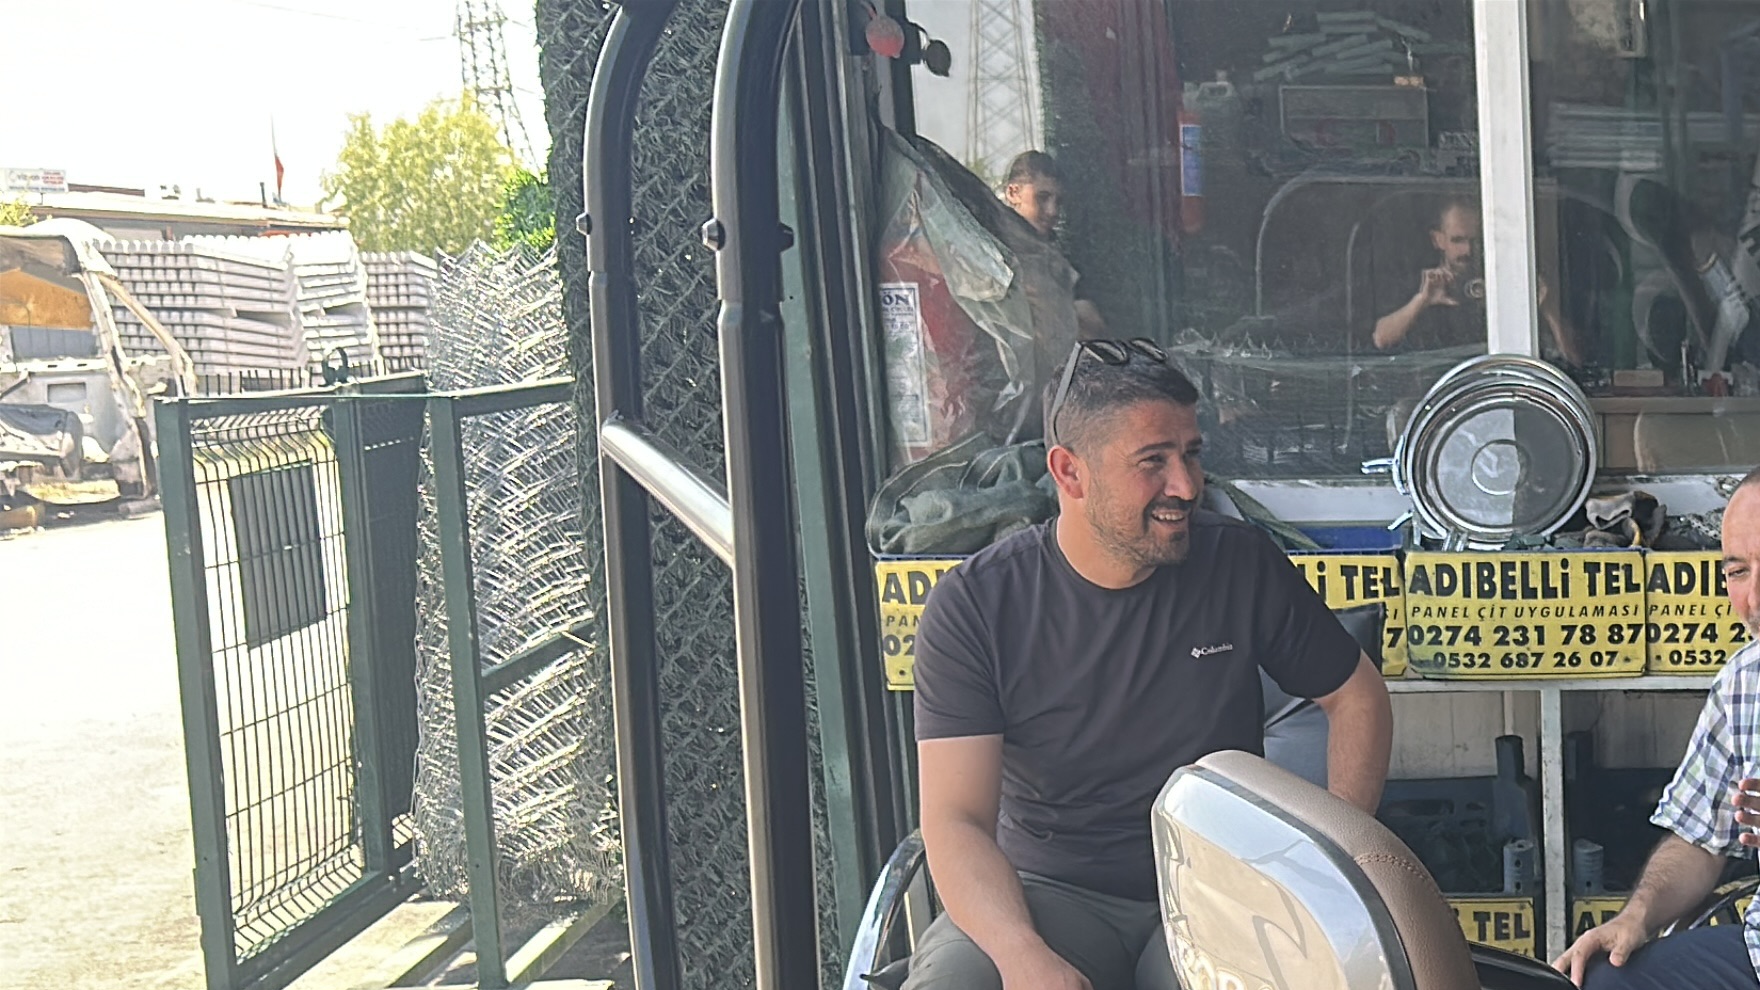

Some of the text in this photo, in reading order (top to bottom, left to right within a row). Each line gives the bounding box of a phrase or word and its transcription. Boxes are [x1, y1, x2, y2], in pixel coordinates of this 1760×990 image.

[882, 290, 910, 306] ÖN
[1336, 564, 1400, 601] TEL
[1583, 561, 1641, 597] TEL
[1646, 559, 1730, 597] ADIB
[1411, 605, 1470, 618] PANEL
[1477, 603, 1507, 621] ÇİT
[1649, 601, 1732, 619] PANEL Çİ
[1408, 623, 1645, 646] 0274 231 78 87
[1647, 622, 1719, 643] 0274
[1433, 650, 1619, 669] 0532 687 26 07
[1668, 649, 1727, 666] 0532
[1473, 911, 1531, 942] TEL
